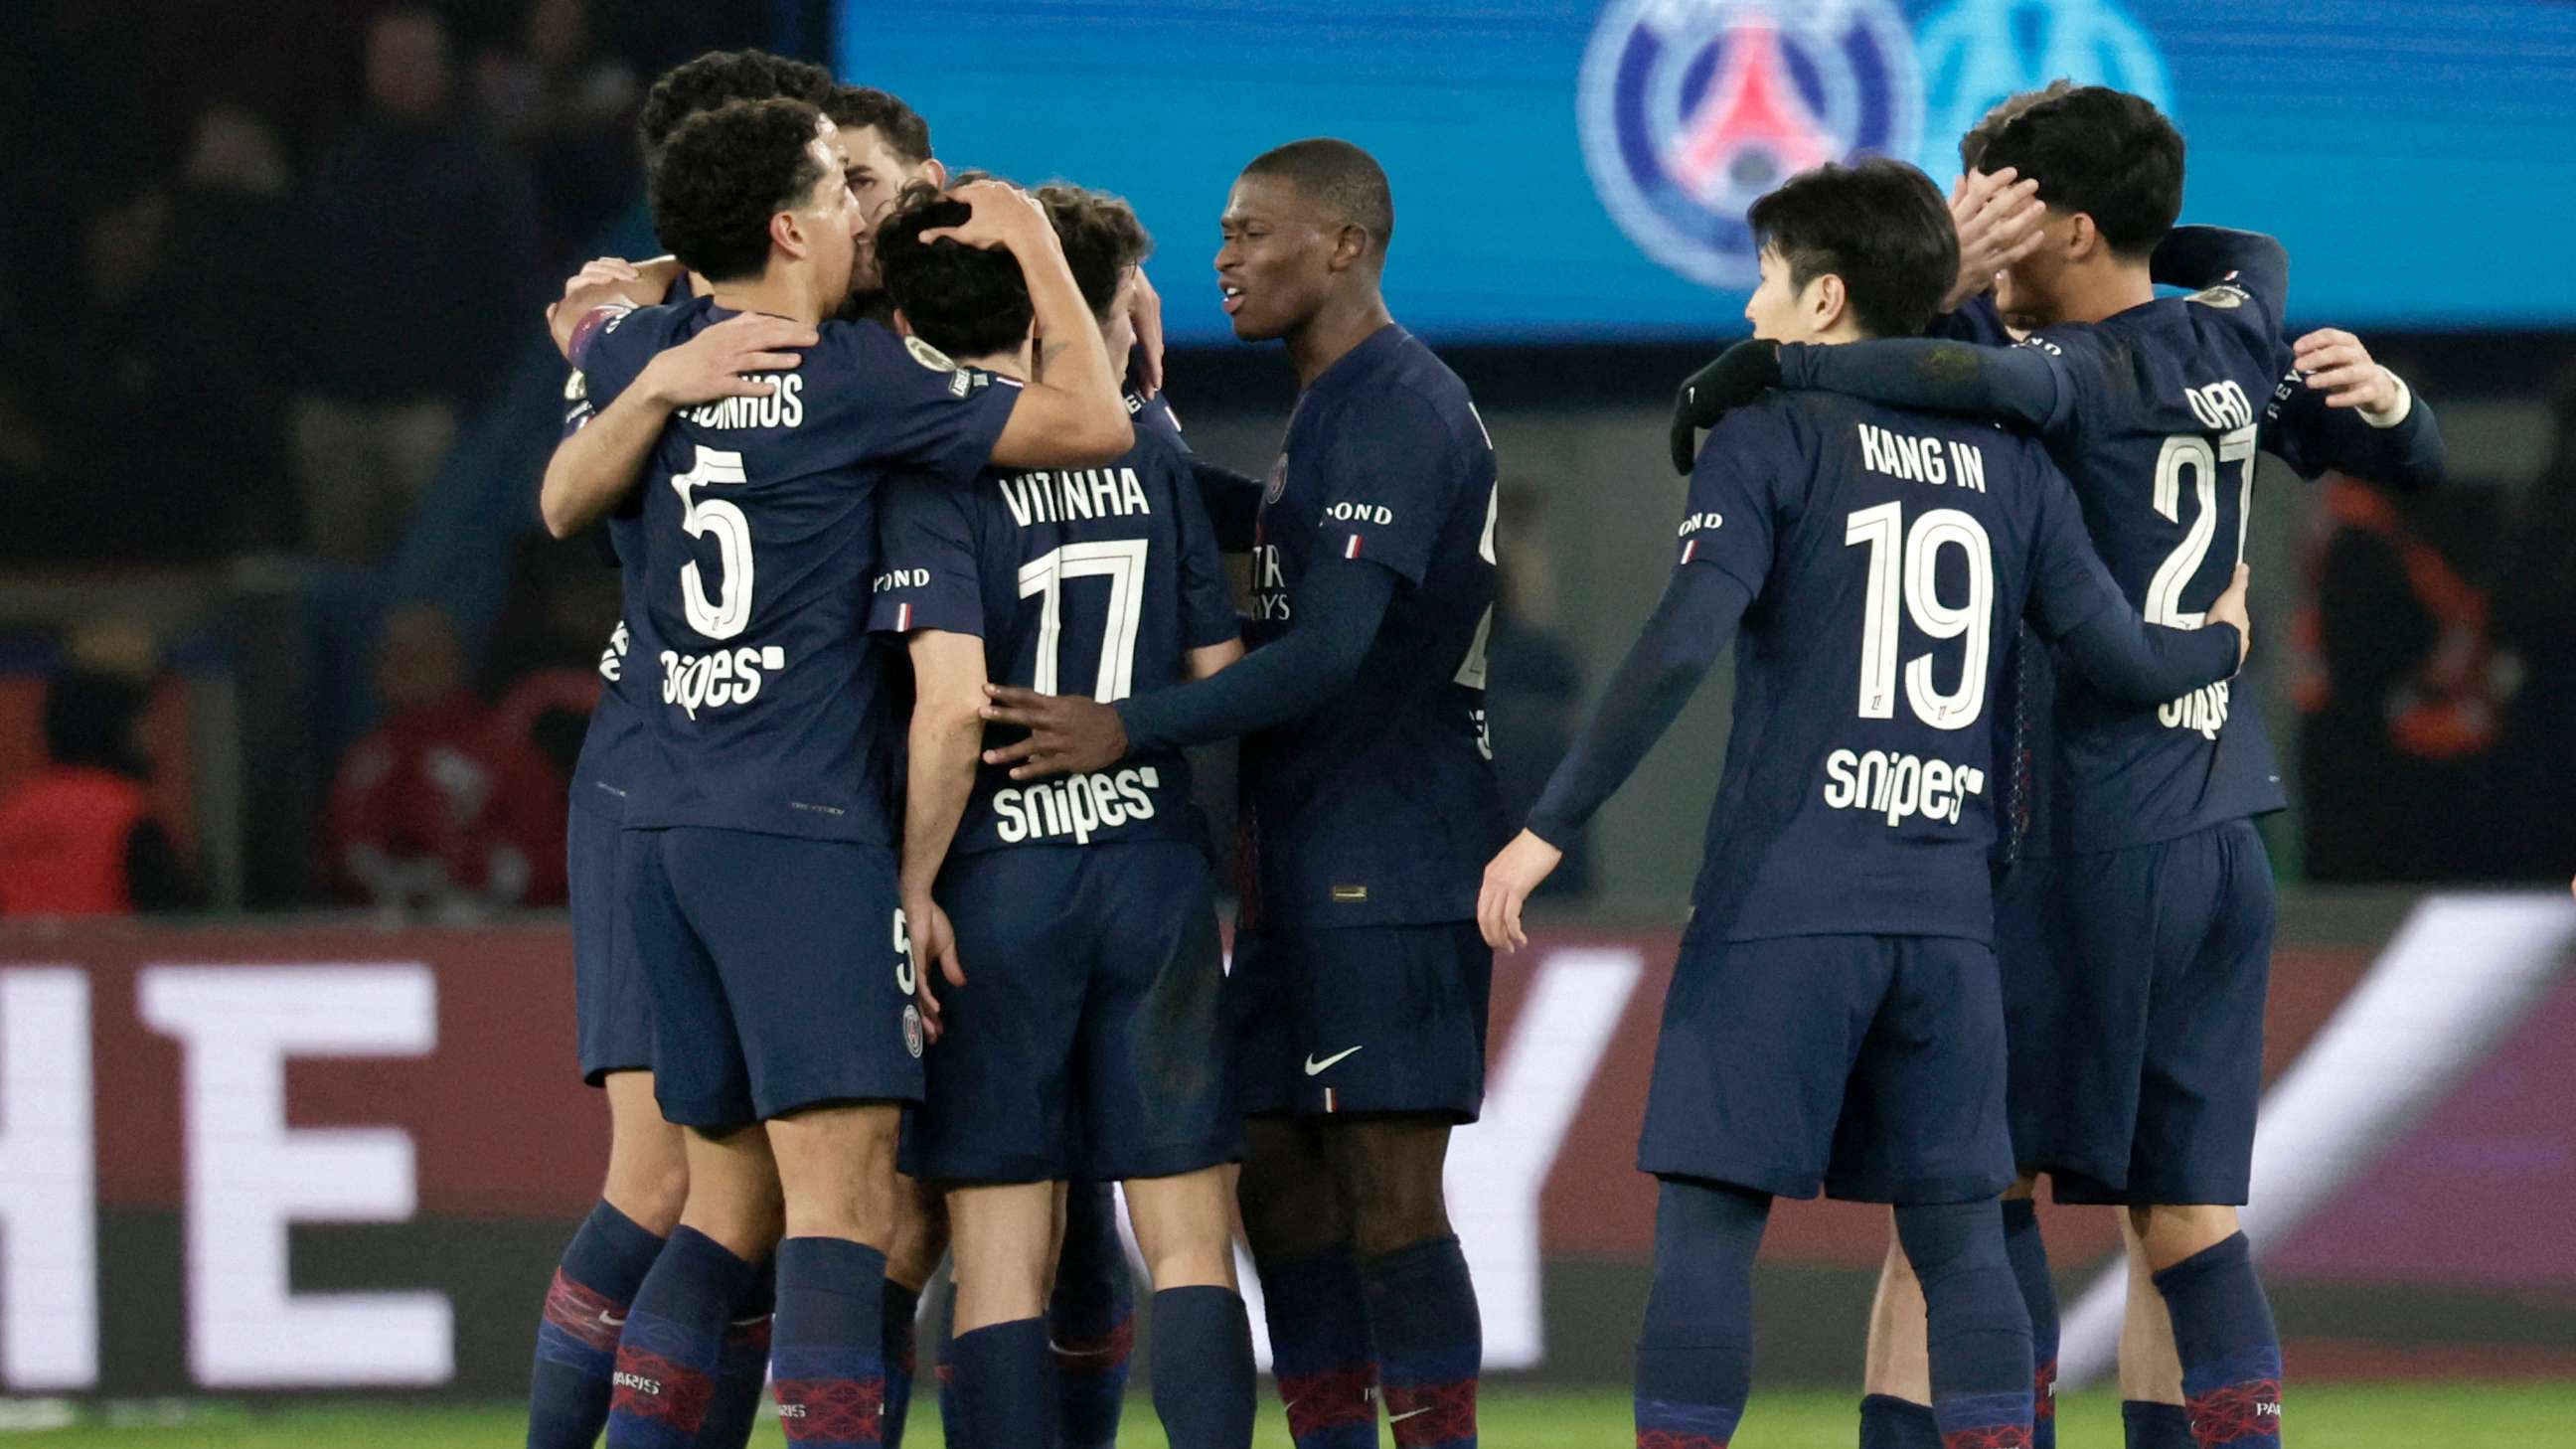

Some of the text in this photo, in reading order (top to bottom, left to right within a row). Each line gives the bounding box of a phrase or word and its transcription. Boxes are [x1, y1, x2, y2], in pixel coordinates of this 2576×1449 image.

[1858, 423, 1986, 493] KANG IN
[999, 468, 1151, 528] VITINHA
[1326, 502, 1393, 526] OND
[1678, 512, 1723, 537] OND
[2145, 422, 2258, 630] 27
[671, 444, 755, 640] 5
[1018, 539, 1149, 705] 17
[1845, 500, 1994, 730] 19
[993, 768, 1155, 845] snipes
[1825, 748, 1969, 827] snipes
[893, 907, 916, 995] 5
